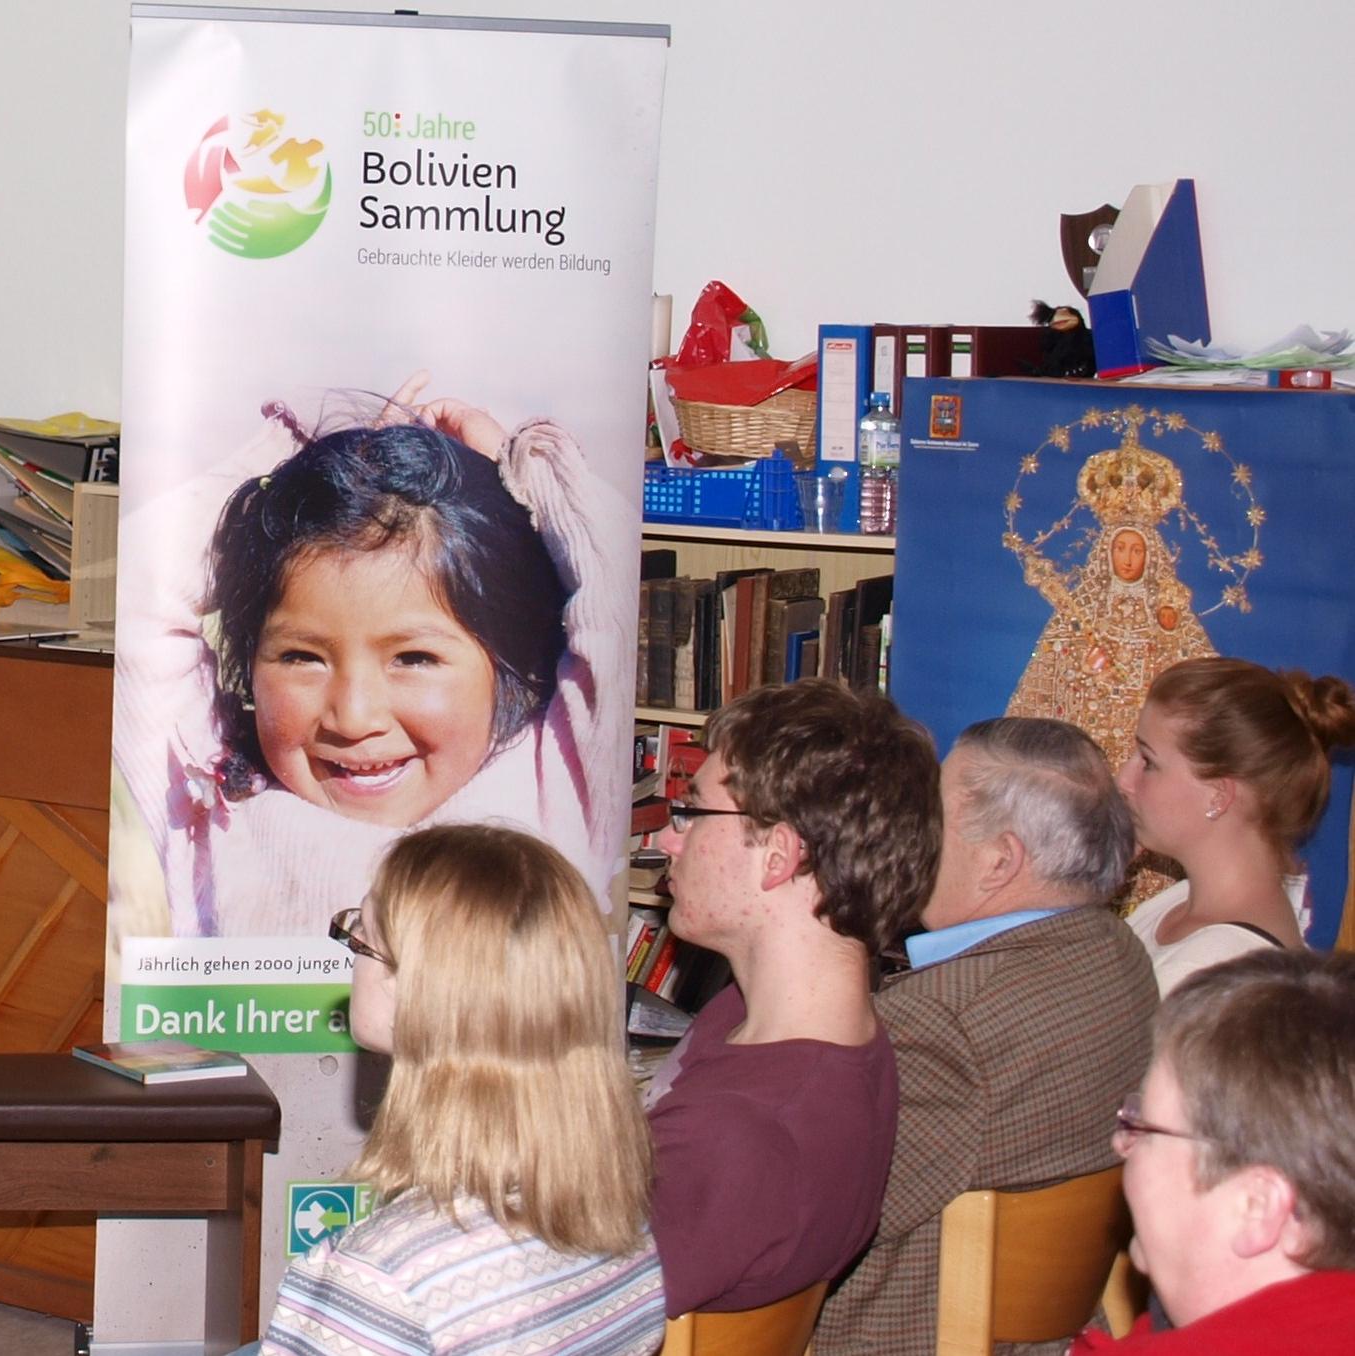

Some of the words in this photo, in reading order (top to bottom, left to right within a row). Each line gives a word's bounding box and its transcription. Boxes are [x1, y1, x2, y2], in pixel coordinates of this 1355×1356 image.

[407, 113, 476, 141] Jahre
[362, 148, 517, 189] Bolivien
[359, 195, 566, 246] Sammlung
[357, 248, 442, 267] Gebrauchte
[447, 250, 497, 268] Kleider
[502, 253, 555, 270] werden
[559, 254, 611, 276] Bildung
[137, 956, 199, 972] Jährlich
[204, 956, 250, 975] gehen
[254, 959, 293, 971] 2000
[296, 956, 340, 975] junge
[135, 999, 226, 1035] Dank
[236, 999, 320, 1034] Ihrer
